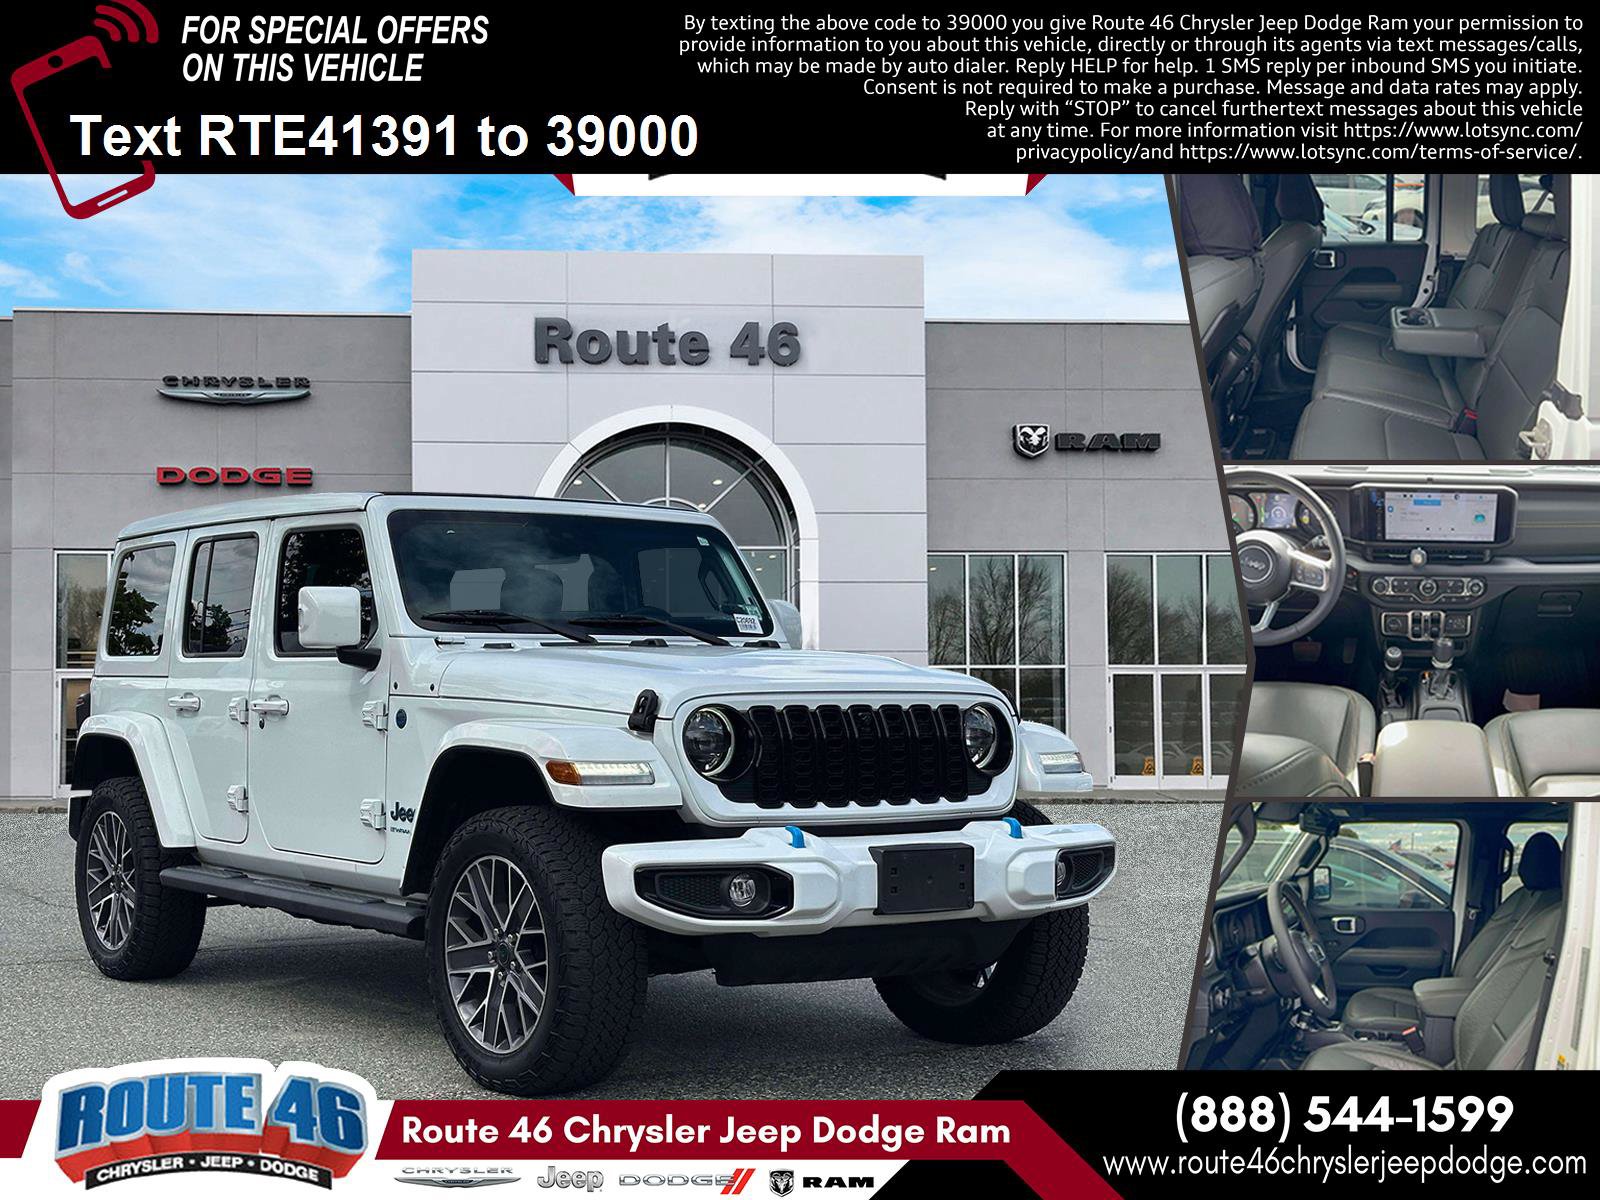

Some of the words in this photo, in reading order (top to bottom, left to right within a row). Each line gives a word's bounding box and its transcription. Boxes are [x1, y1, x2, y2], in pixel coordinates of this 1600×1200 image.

[534, 317, 711, 366] Route
[729, 321, 802, 367] 46
[161, 375, 311, 388] CHRYSLER
[1054, 432, 1161, 452] RAM
[156, 466, 313, 486] DODGE
